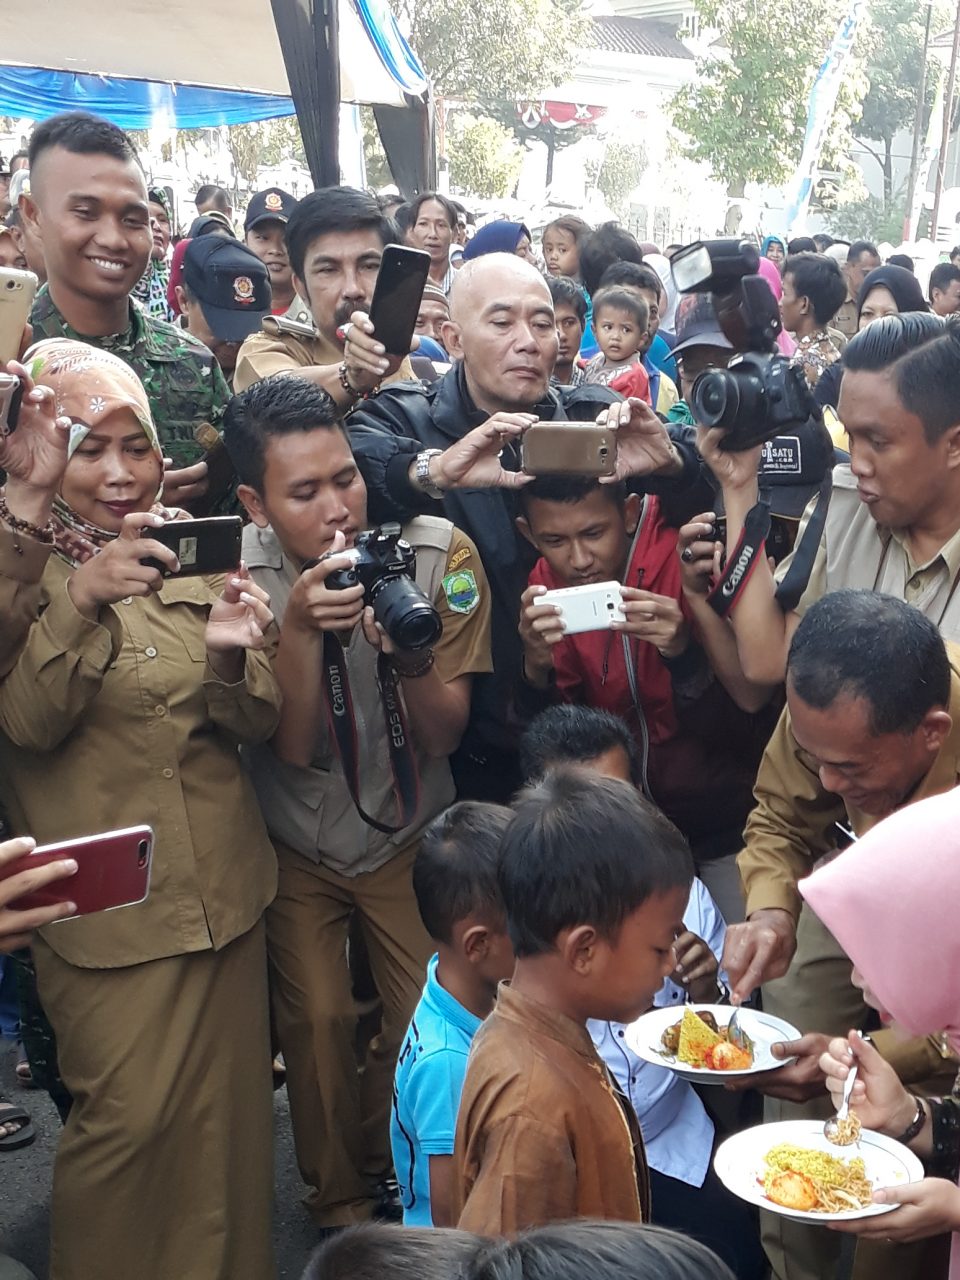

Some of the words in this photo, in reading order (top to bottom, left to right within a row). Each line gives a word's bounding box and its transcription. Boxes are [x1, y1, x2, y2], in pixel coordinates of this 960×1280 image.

[722, 545, 753, 596] Canon
[328, 664, 346, 717] Canon
[389, 712, 405, 748] EOS
